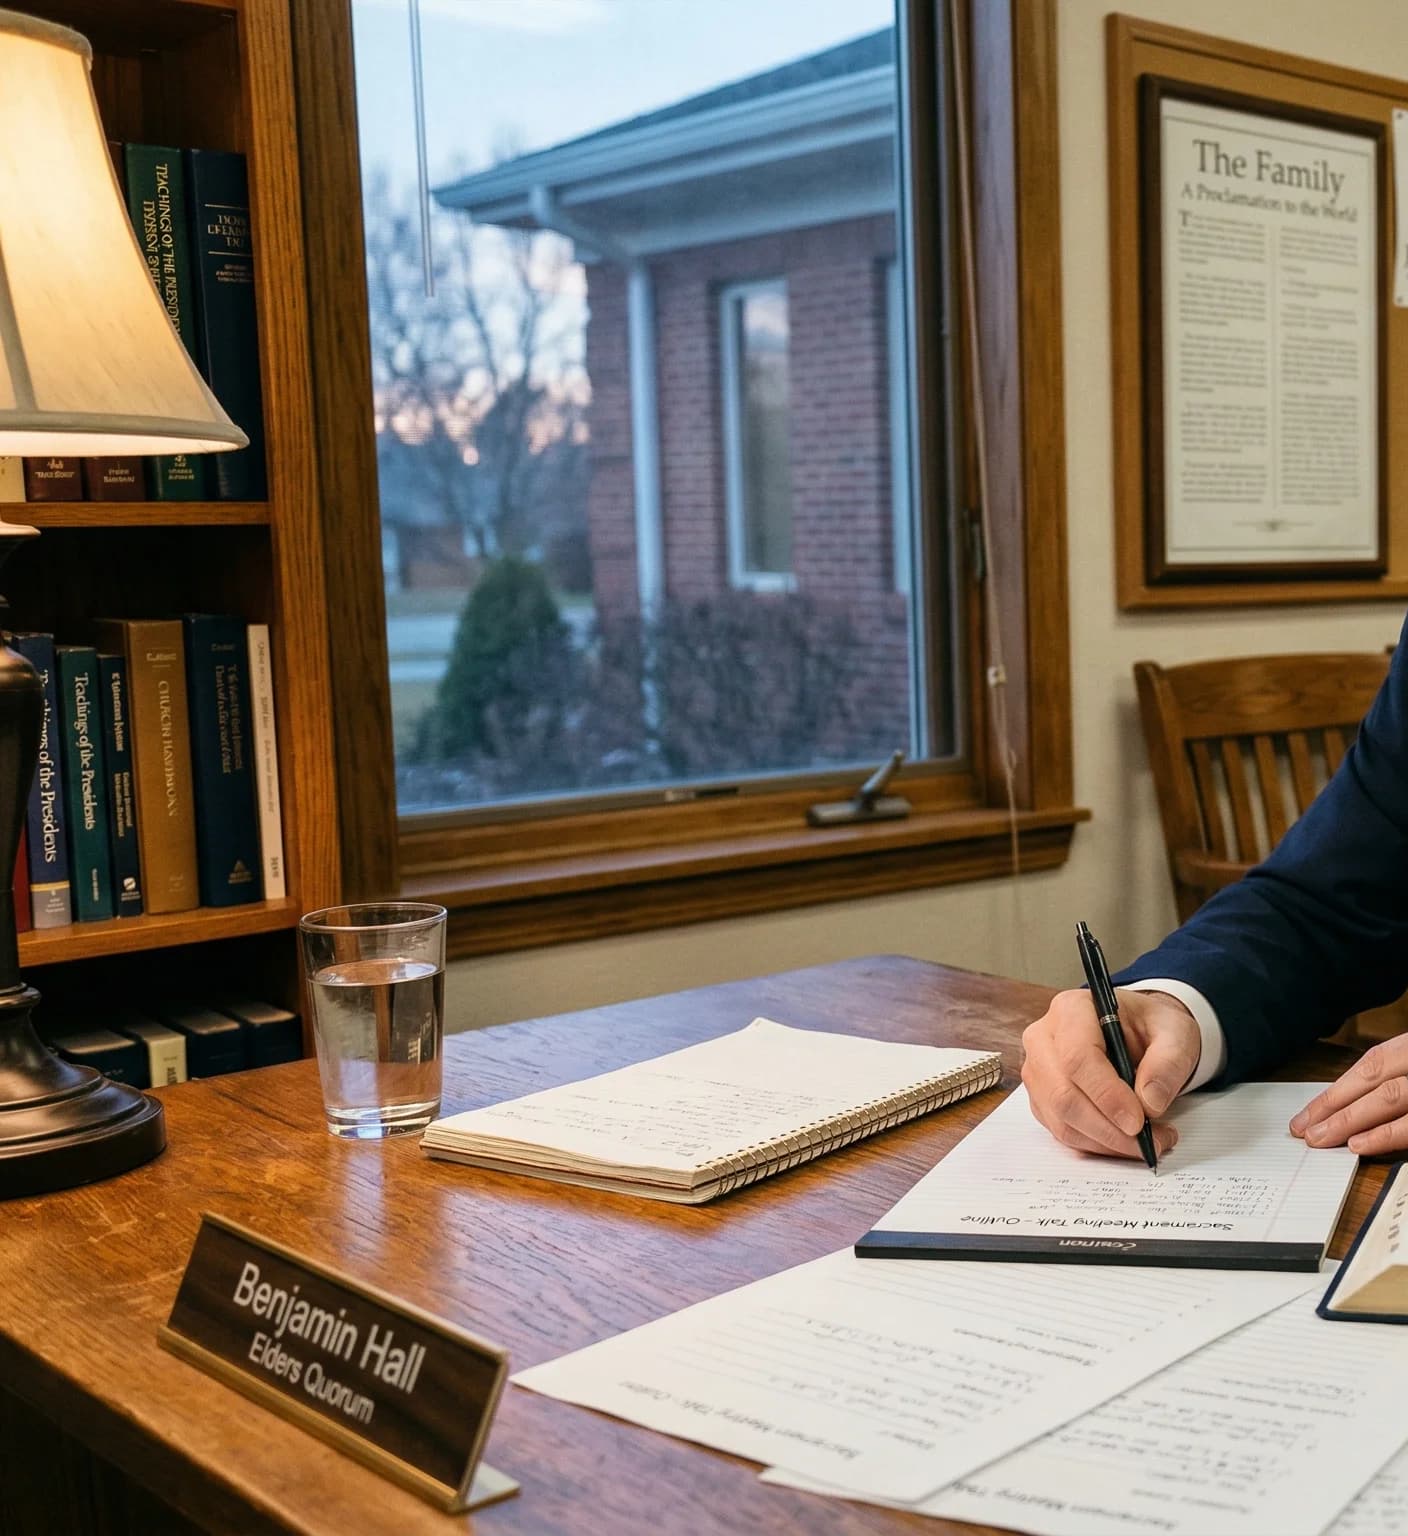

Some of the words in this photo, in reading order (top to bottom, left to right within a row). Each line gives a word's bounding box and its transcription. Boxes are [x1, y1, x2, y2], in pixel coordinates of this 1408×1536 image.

[1192, 138, 1247, 179] The
[1255, 149, 1345, 204] Family
[1181, 182, 1194, 200] A
[1284, 199, 1298, 215] to
[1300, 200, 1320, 217] the
[74, 672, 90, 734] Teachings
[75, 735, 93, 750] of
[39, 751, 54, 767] of
[39, 767, 55, 788] the
[41, 791, 60, 863] Presidents
[960, 1214, 1020, 1225] Outline
[1035, 1216, 1069, 1227] Talk
[1073, 1216, 1138, 1229] Meeting
[1141, 1219, 1234, 1231] Sacrament
[233, 1261, 358, 1362] Benjamin
[359, 1324, 427, 1394] Hall
[248, 1332, 304, 1385] Elders
[303, 1363, 375, 1425] Quorum
